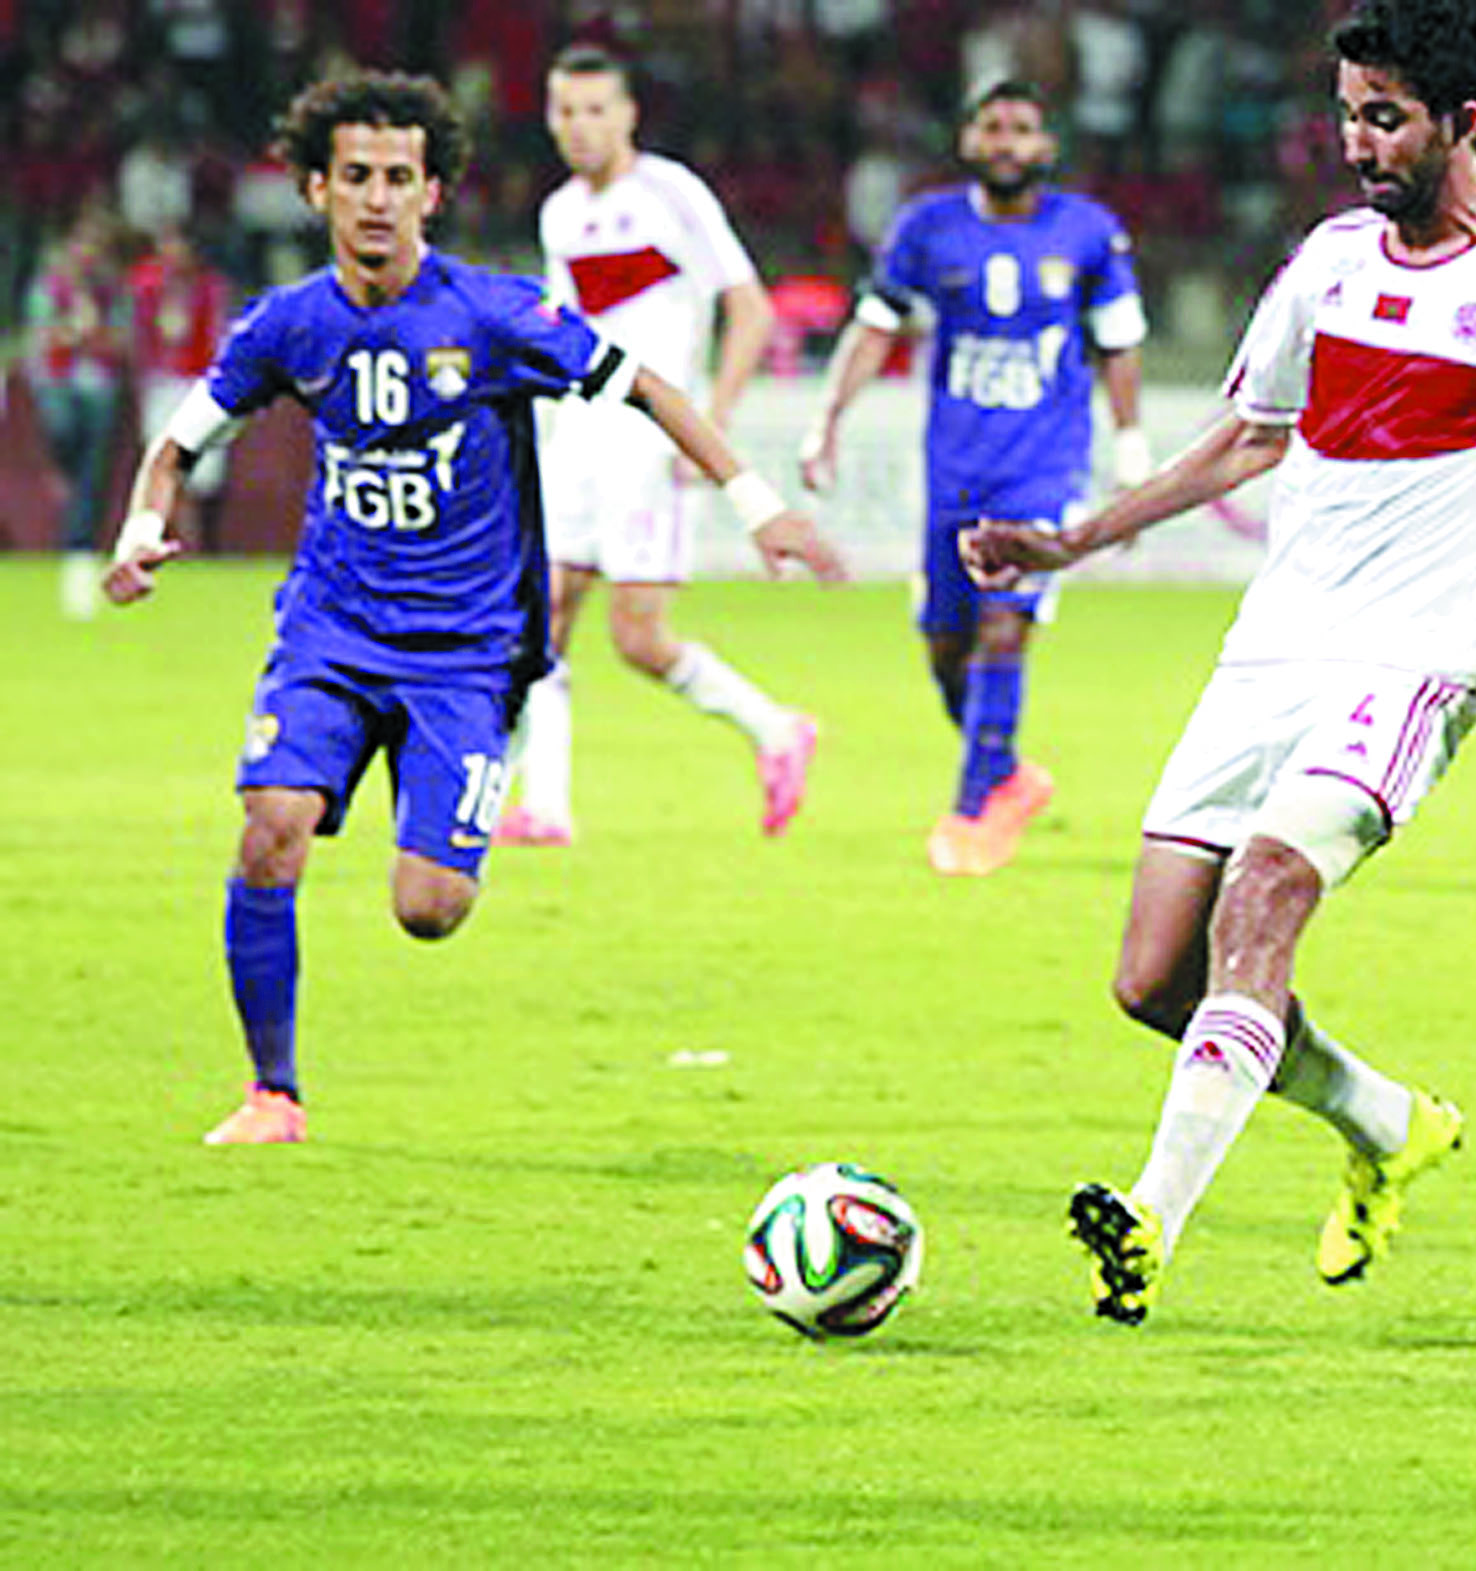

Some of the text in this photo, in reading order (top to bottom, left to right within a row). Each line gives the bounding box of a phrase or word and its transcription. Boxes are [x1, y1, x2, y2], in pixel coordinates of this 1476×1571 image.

[348, 349, 410, 426] 16
[949, 348, 1043, 410] FGB
[323, 442, 437, 532] FGB
[1348, 692, 1376, 728] 4
